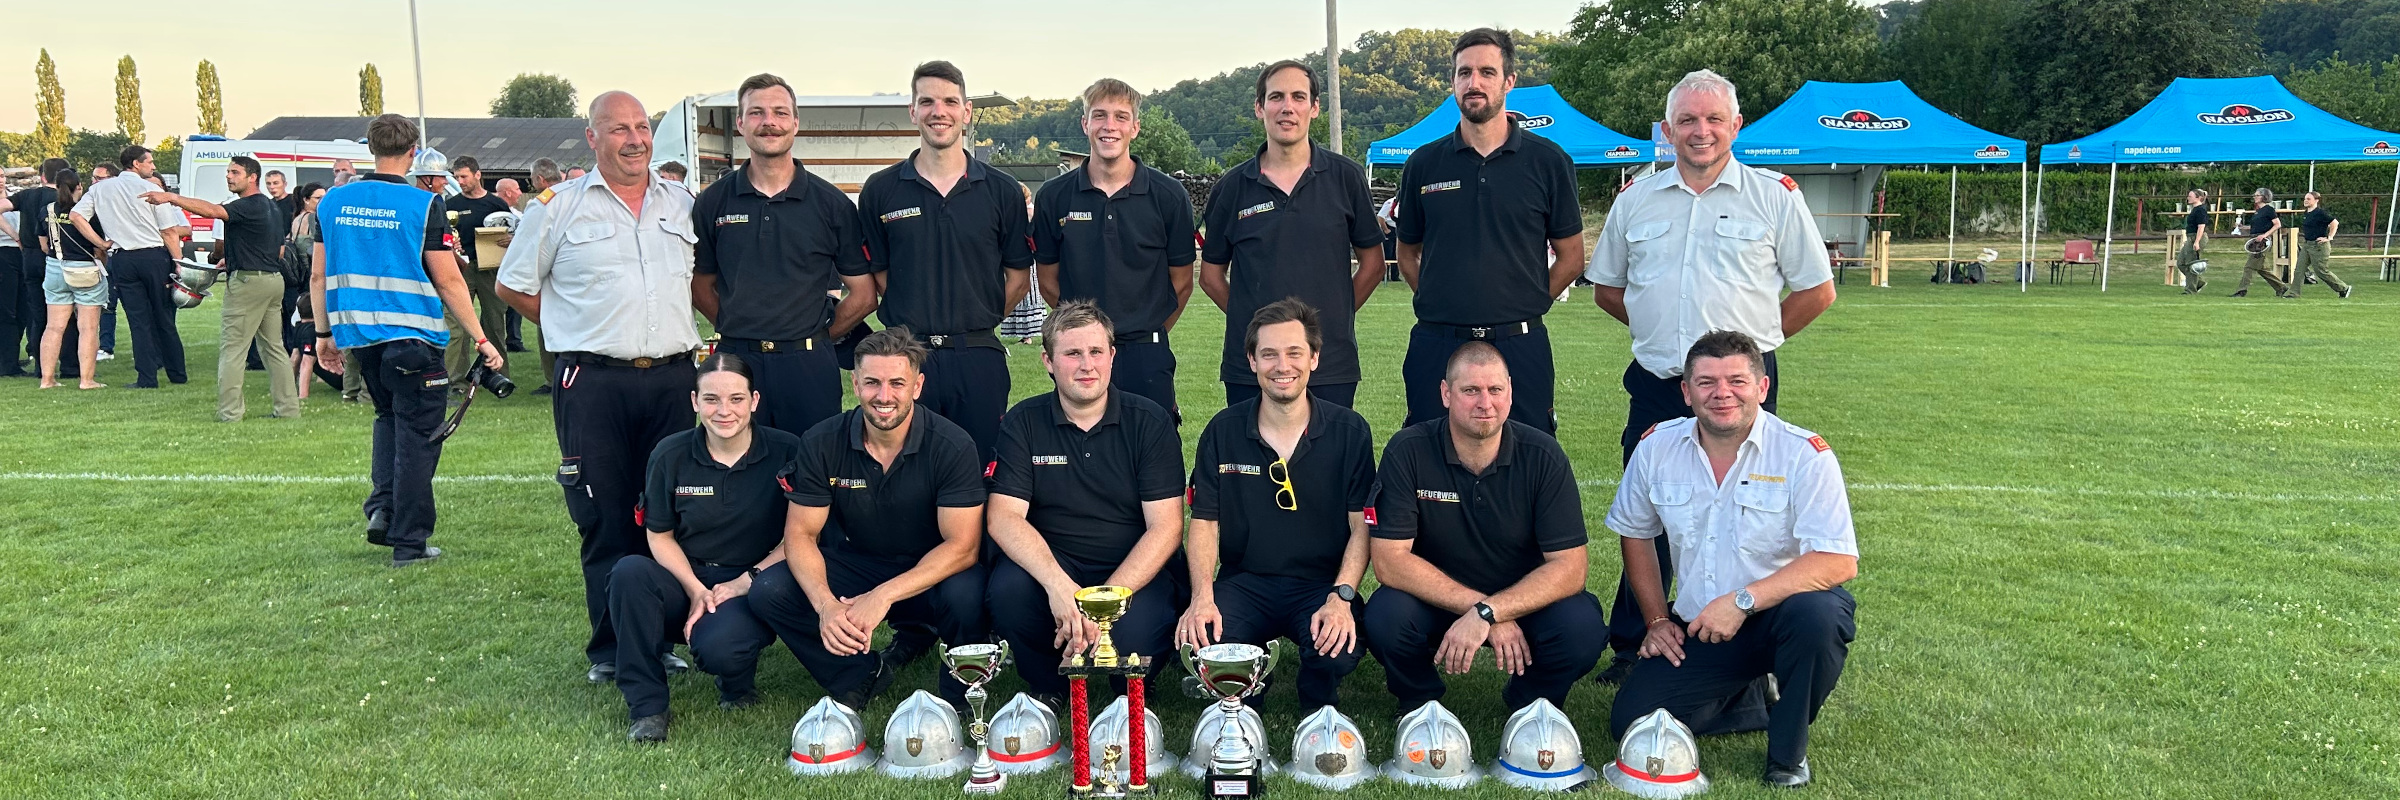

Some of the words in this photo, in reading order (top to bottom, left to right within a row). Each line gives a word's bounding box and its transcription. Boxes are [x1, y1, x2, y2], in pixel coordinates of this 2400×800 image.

[2203, 111, 2288, 124] NAPOLEON
[1823, 118, 1904, 129] NAPOLEON
[1744, 147, 1800, 157] napoleon.com
[2124, 146, 2182, 156] napoleon.com
[341, 205, 397, 218] FEUERWEHR
[335, 216, 401, 235] PRESSEDIENST
[1032, 455, 1068, 464] EUERWEHR
